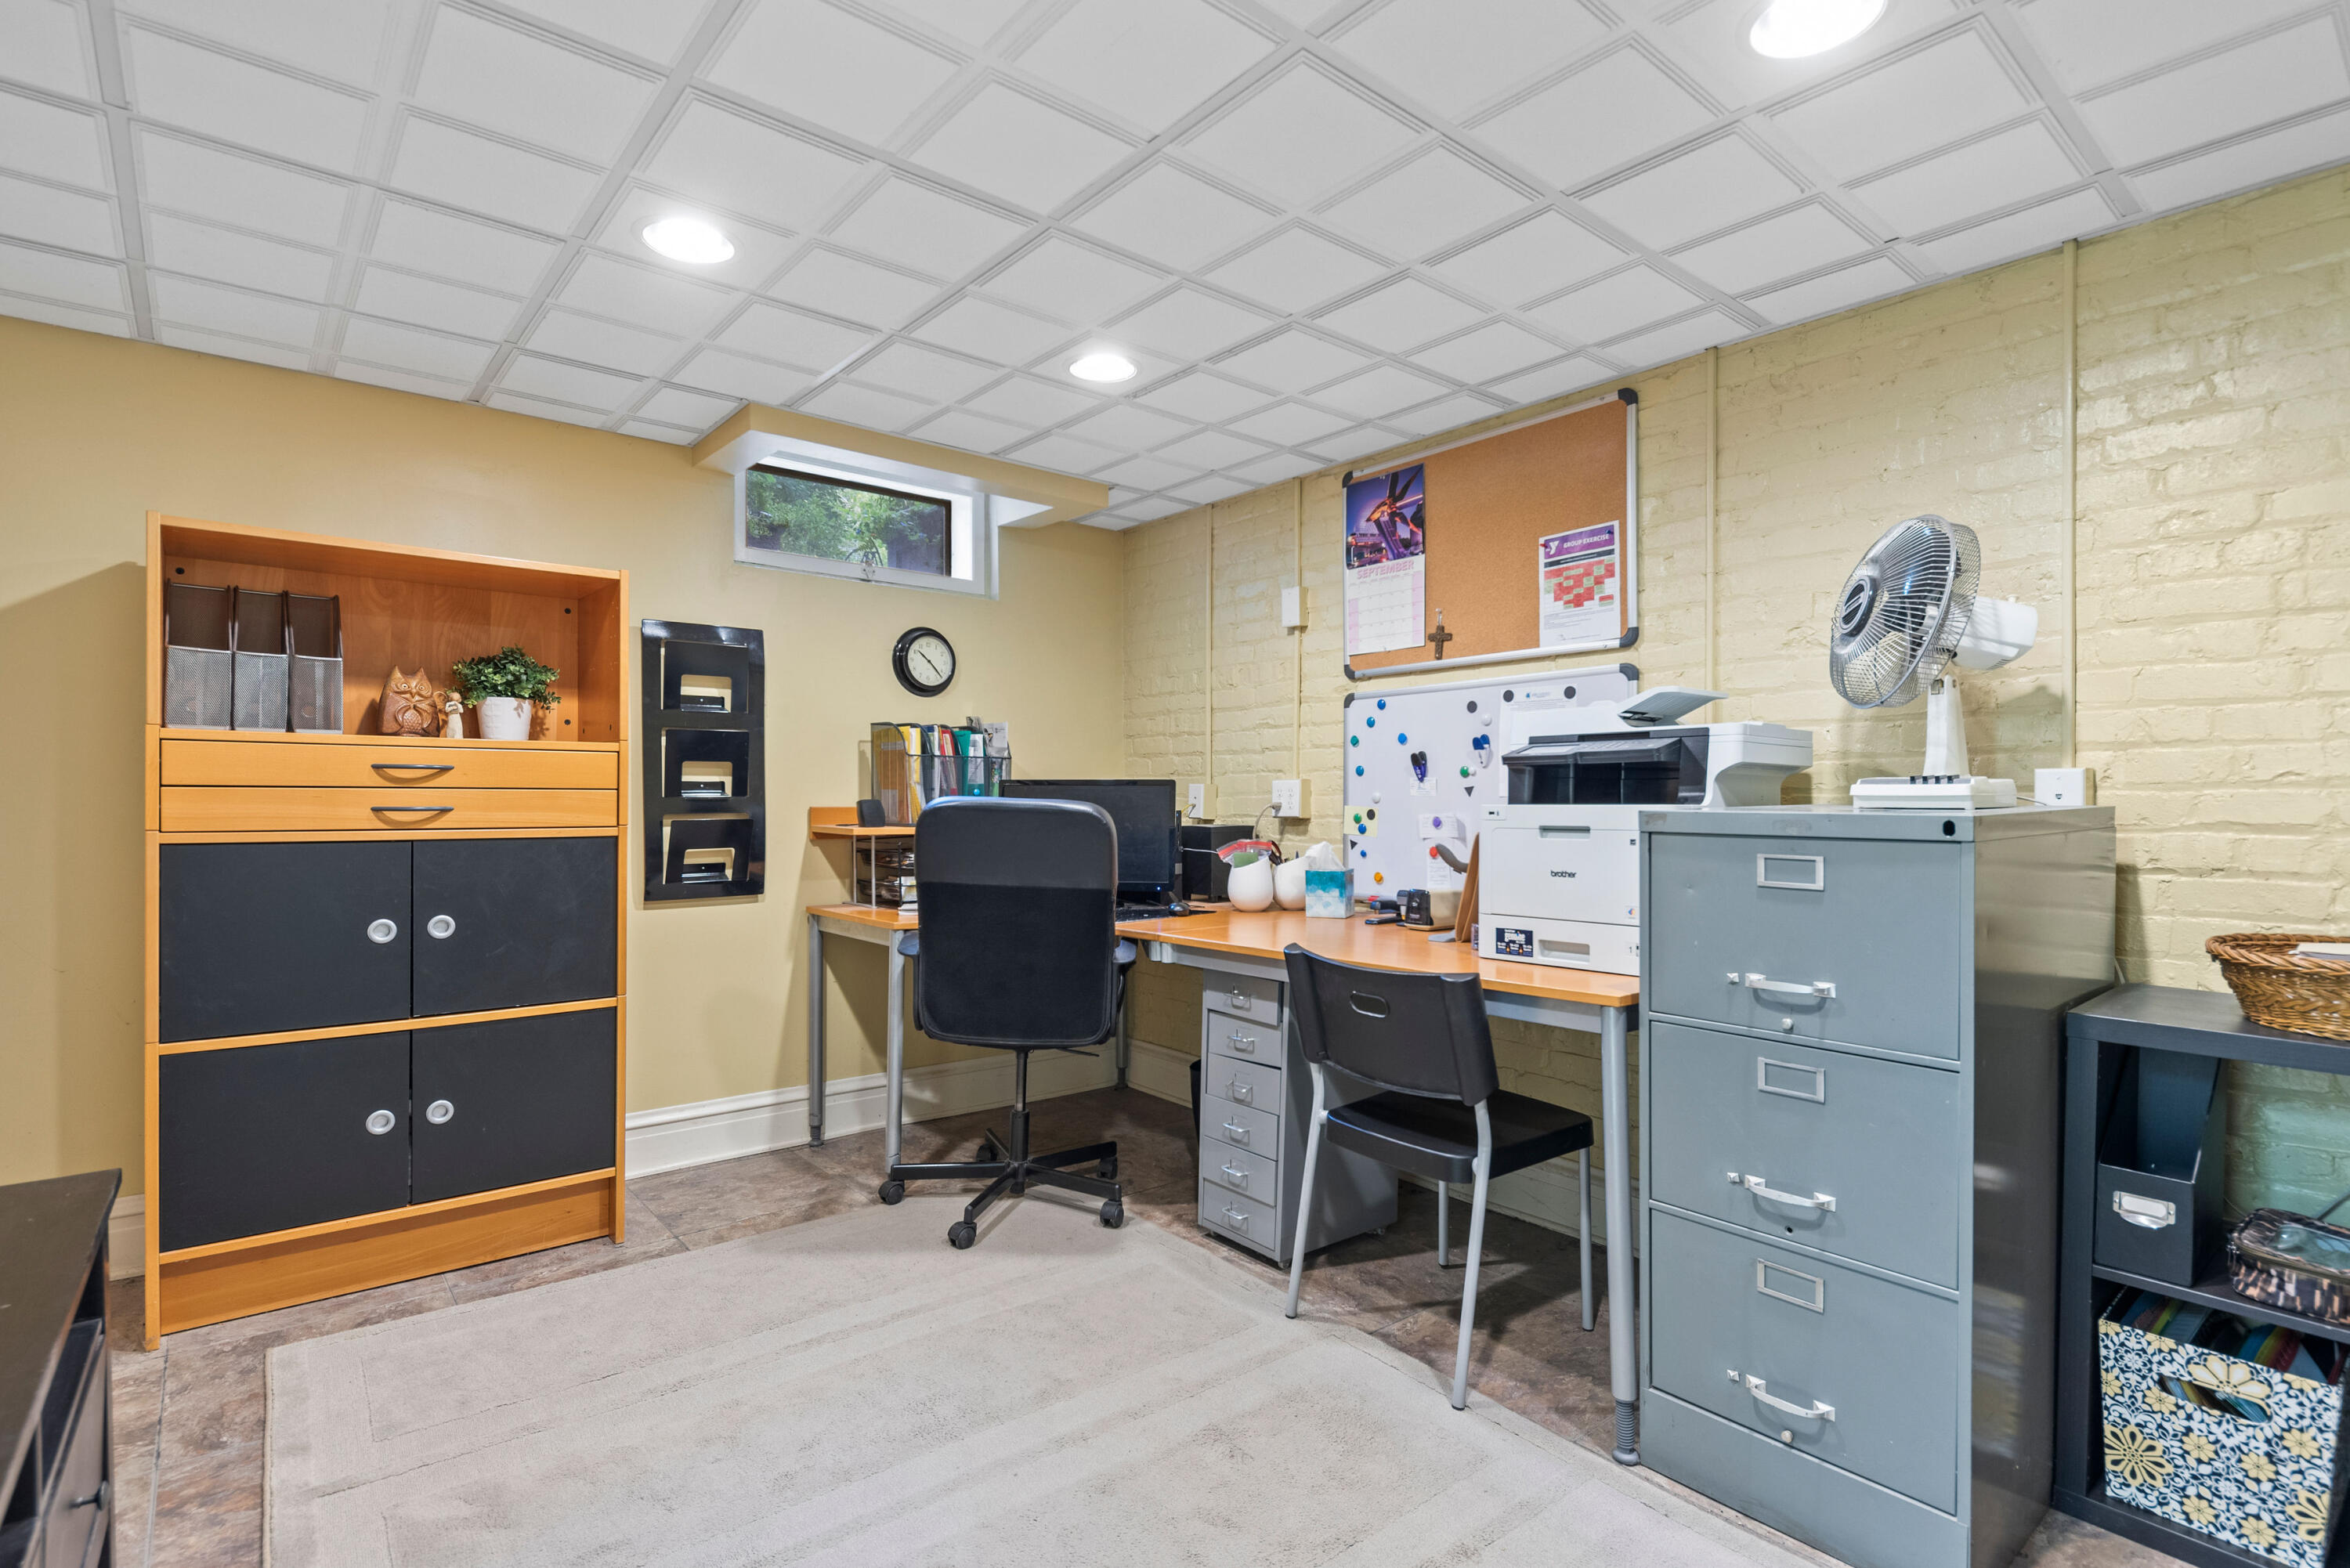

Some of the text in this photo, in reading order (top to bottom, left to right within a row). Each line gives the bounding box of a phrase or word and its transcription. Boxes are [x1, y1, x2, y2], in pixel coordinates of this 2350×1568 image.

[1564, 540, 1582, 548] GROUP
[1582, 533, 1609, 544] EXERCISE
[1357, 559, 1414, 580] SEPTEMBER
[1550, 869, 1577, 878] brother
